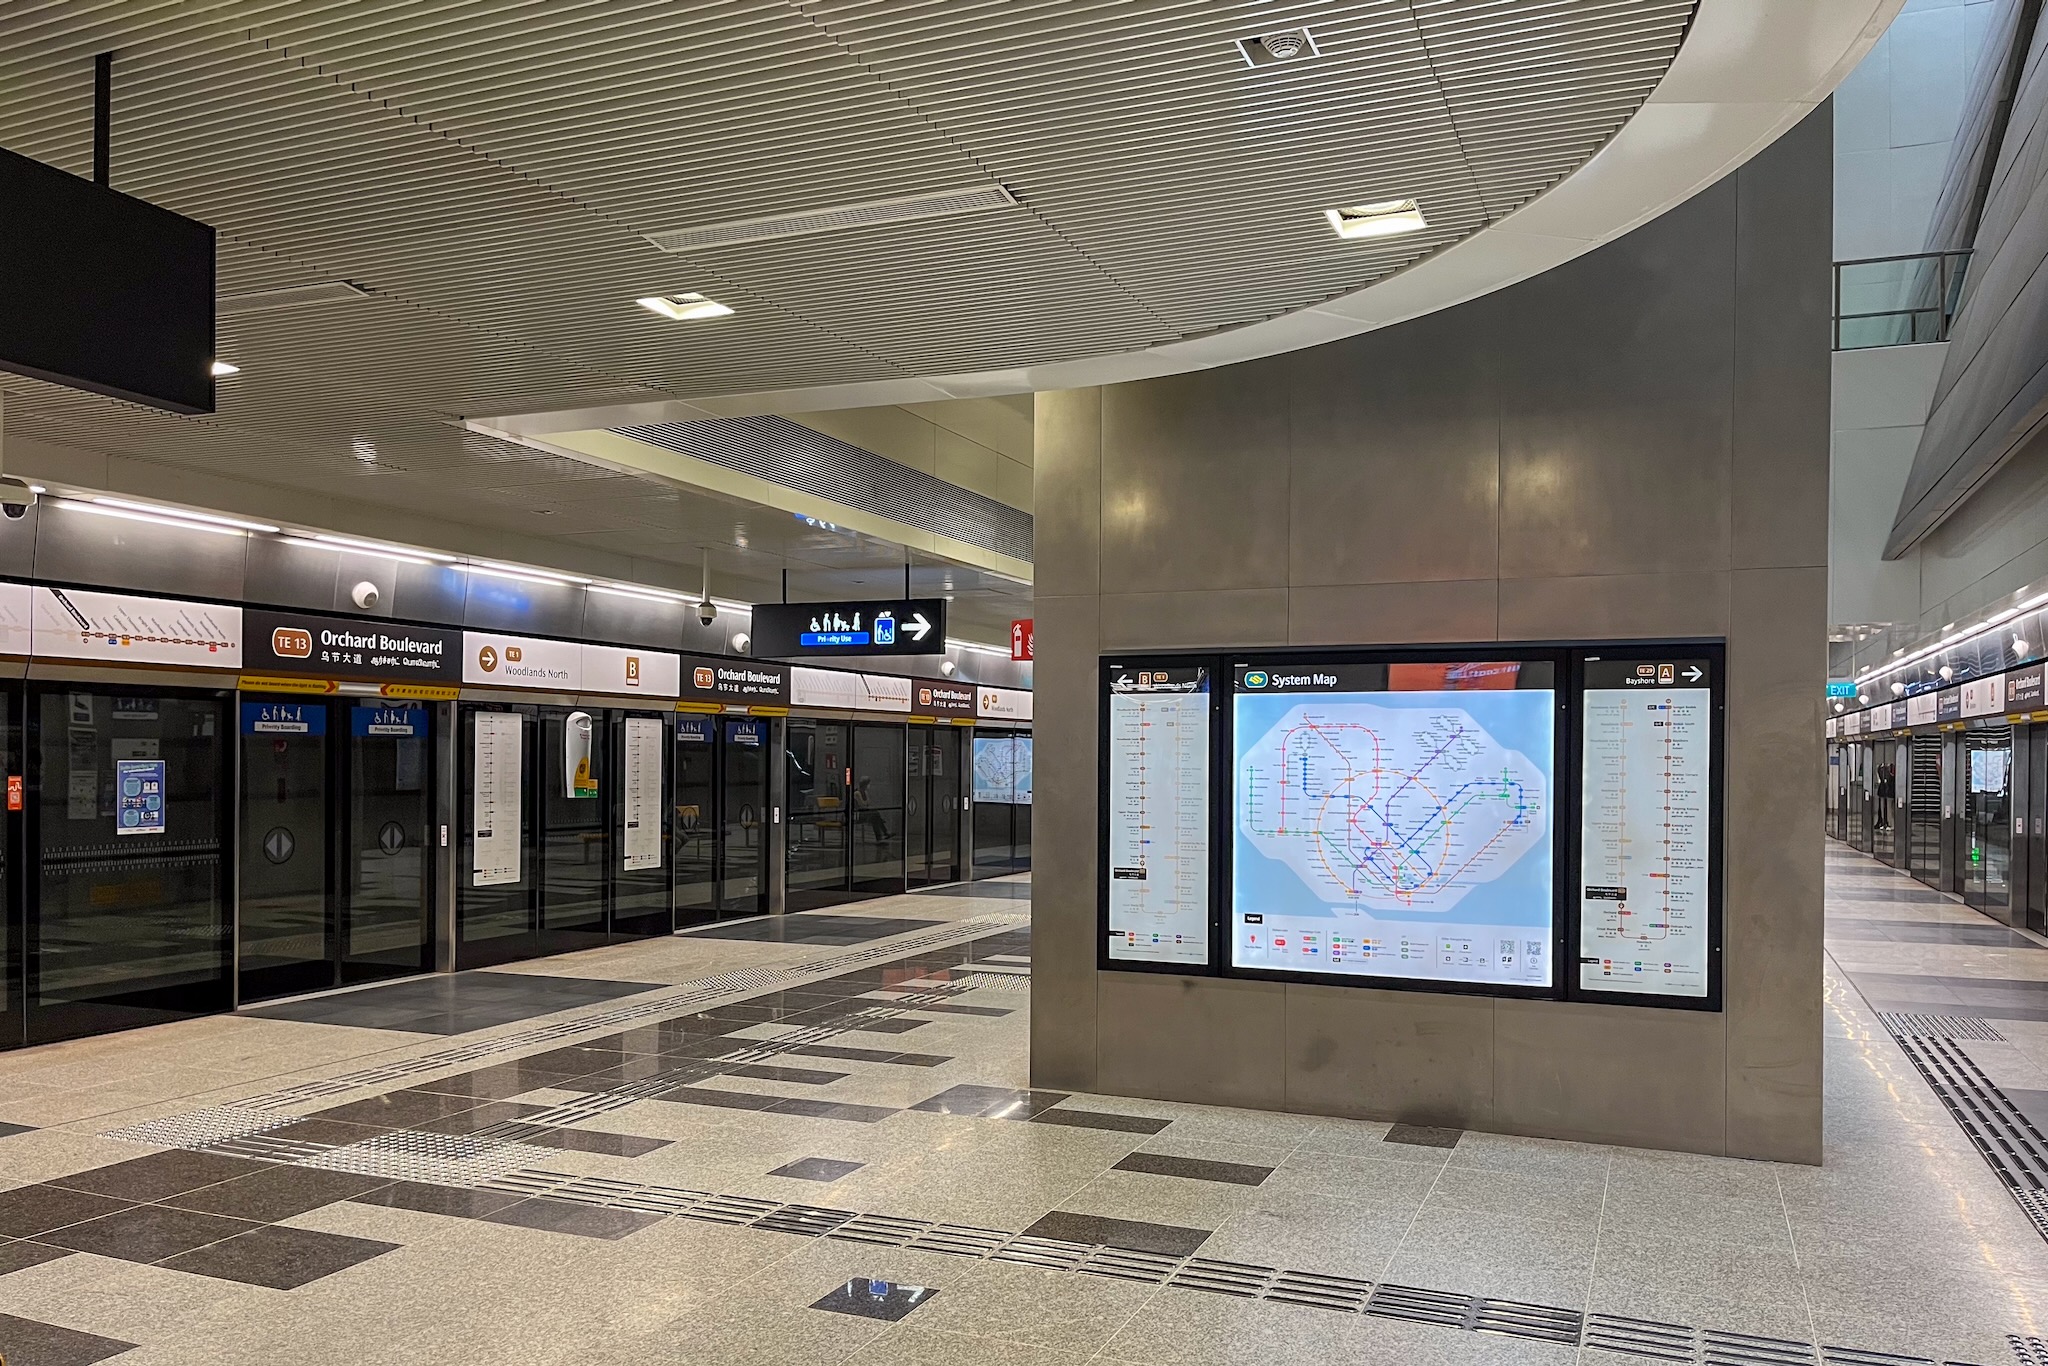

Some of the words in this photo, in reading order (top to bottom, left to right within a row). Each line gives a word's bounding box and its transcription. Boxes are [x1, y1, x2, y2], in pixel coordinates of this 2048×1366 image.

[278, 636, 290, 648] TE
[294, 638, 306, 649] 13
[321, 630, 376, 649] Orchard
[380, 635, 443, 655] Boulevard
[321, 651, 362, 664] 乌节大道
[509, 650, 515, 658] TE
[505, 666, 546, 678] Woodlands
[548, 669, 568, 679] North
[630, 662, 636, 676] B
[1662, 668, 1670, 677] A
[696, 673, 703, 682] TE
[705, 674, 711, 683] 13
[718, 668, 746, 682] Orchard
[748, 670, 780, 684] Boulevard
[1142, 675, 1148, 683] B
[1272, 674, 1311, 687] System
[1314, 673, 1337, 687] Map
[1831, 686, 1850, 695] EXIT
